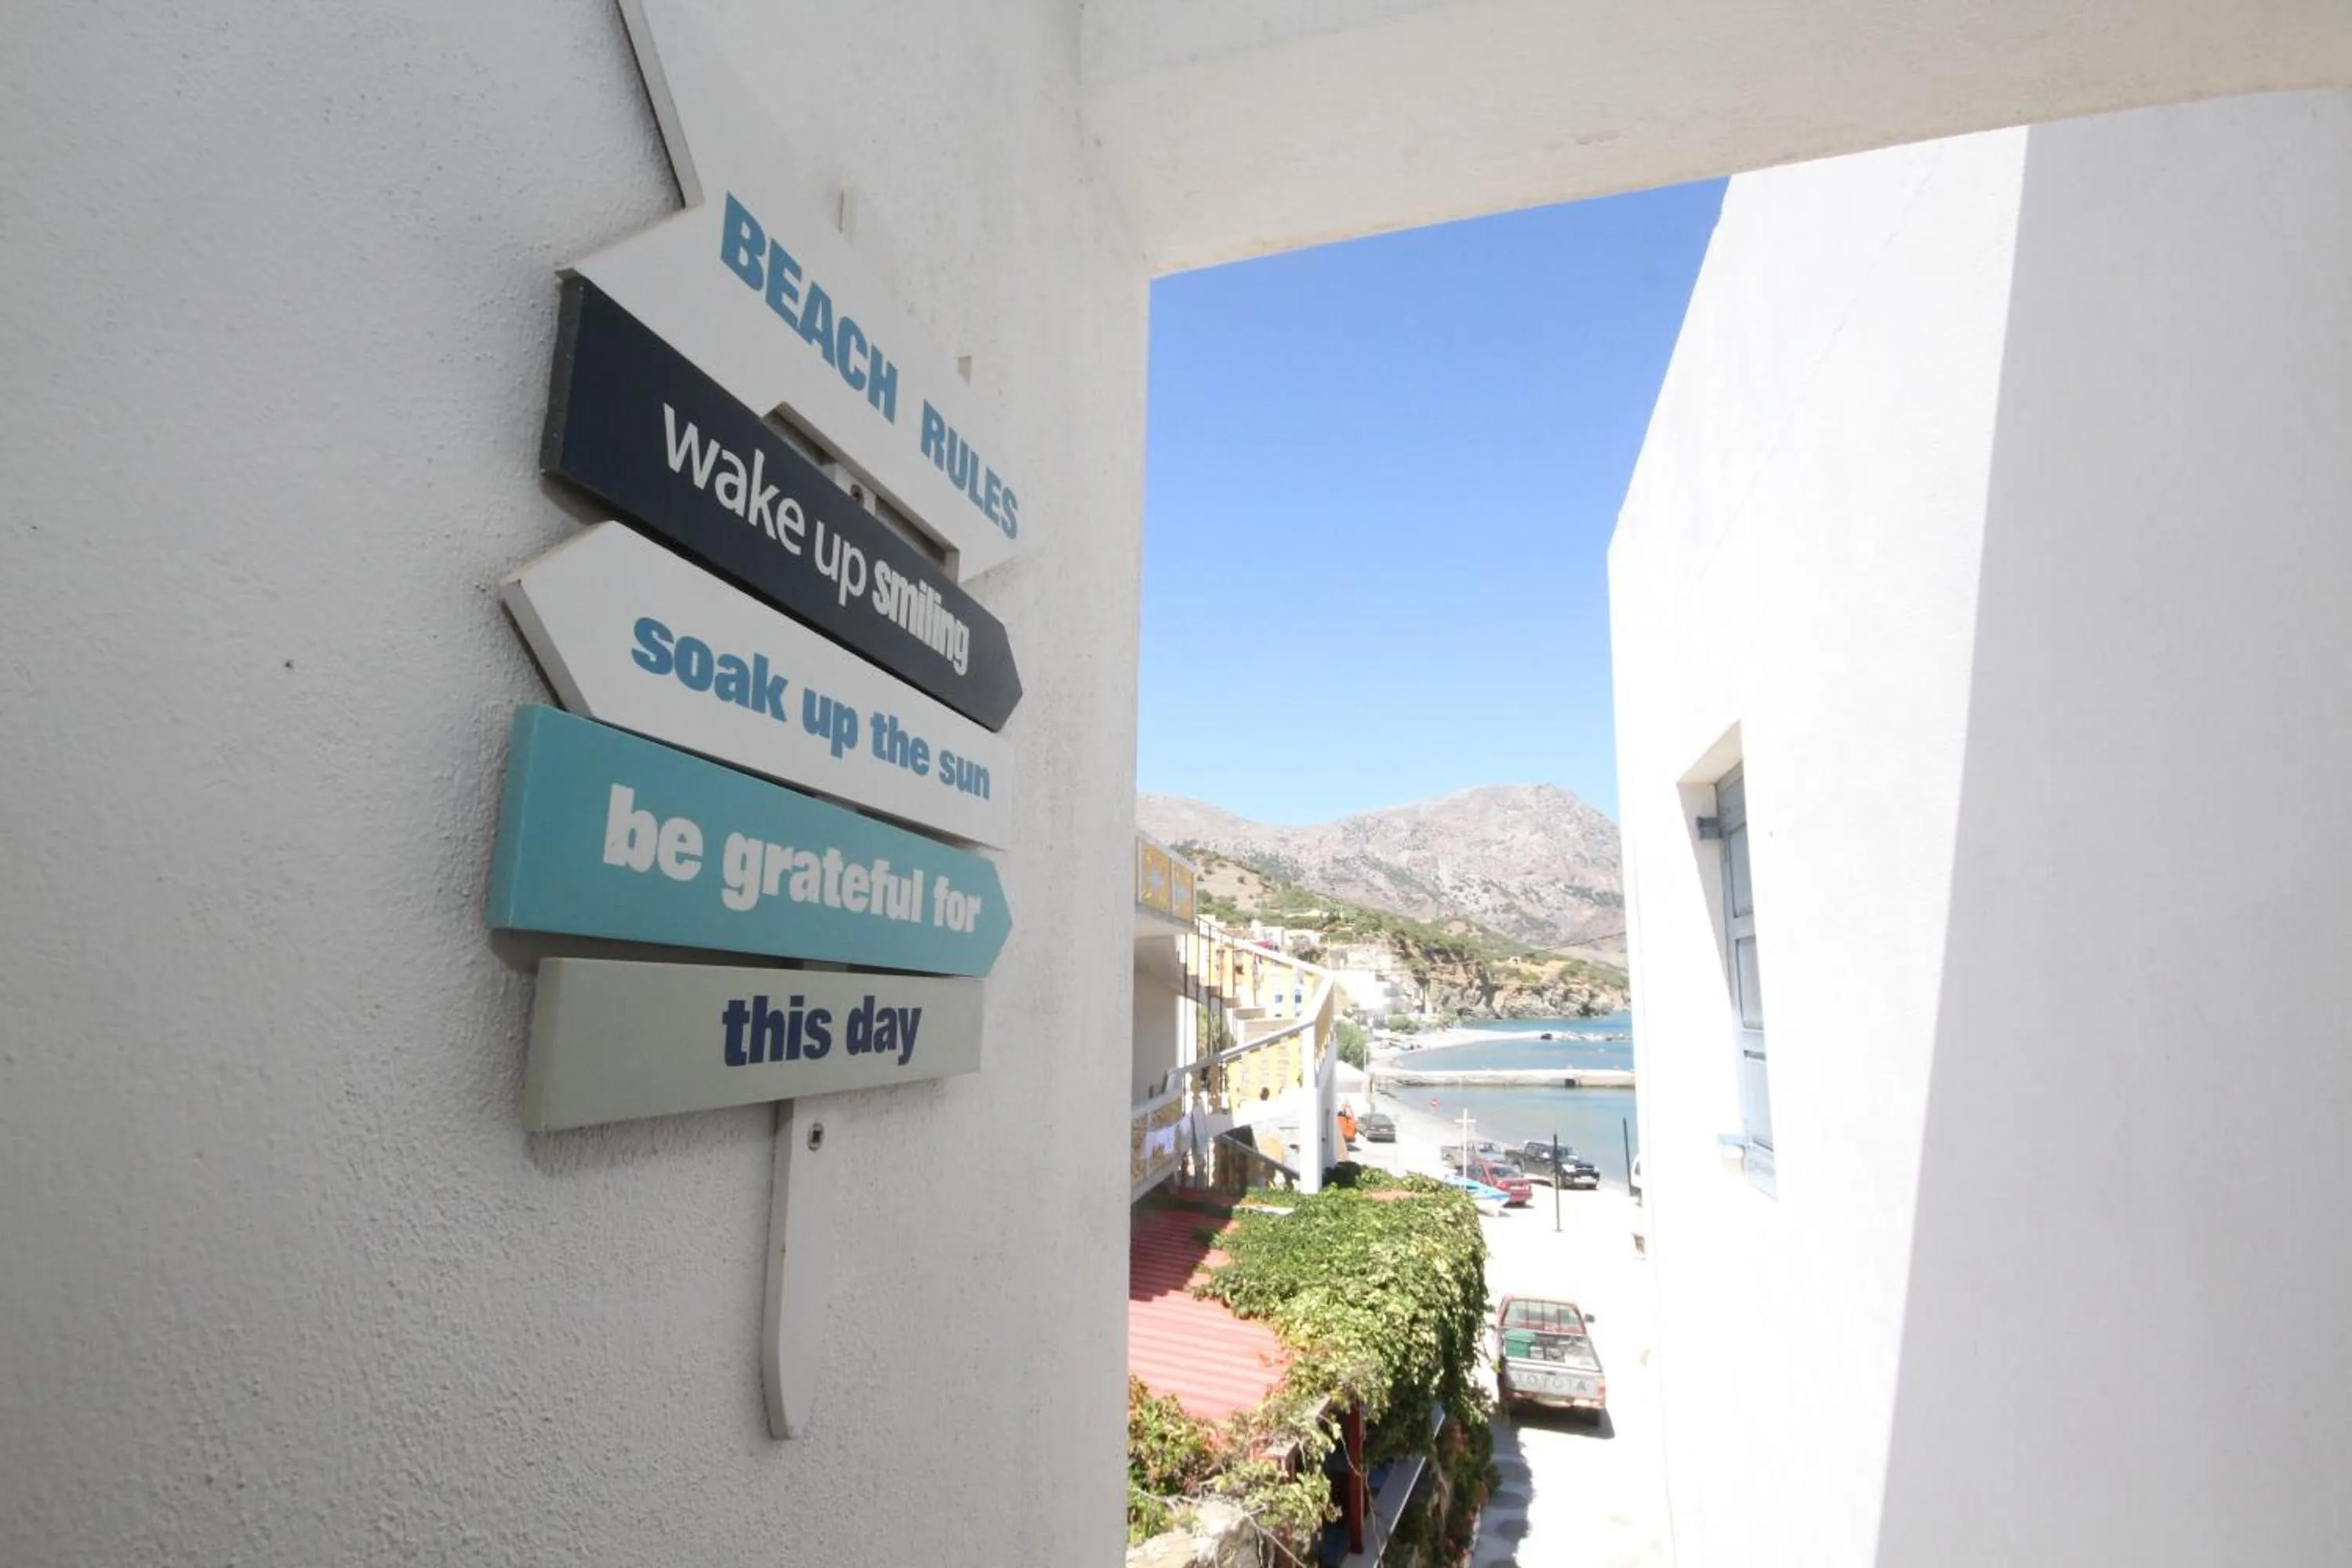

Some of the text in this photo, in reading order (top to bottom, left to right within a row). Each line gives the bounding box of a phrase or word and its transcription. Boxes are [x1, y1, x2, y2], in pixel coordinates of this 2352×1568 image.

[721, 191, 1018, 539] BEACH RULES
[662, 401, 969, 675] wake up smiling
[631, 617, 989, 800] soak up the sun
[604, 783, 981, 932] be grateful for
[721, 995, 921, 1066] this day
[1515, 1372, 1587, 1392] TOYOTA
